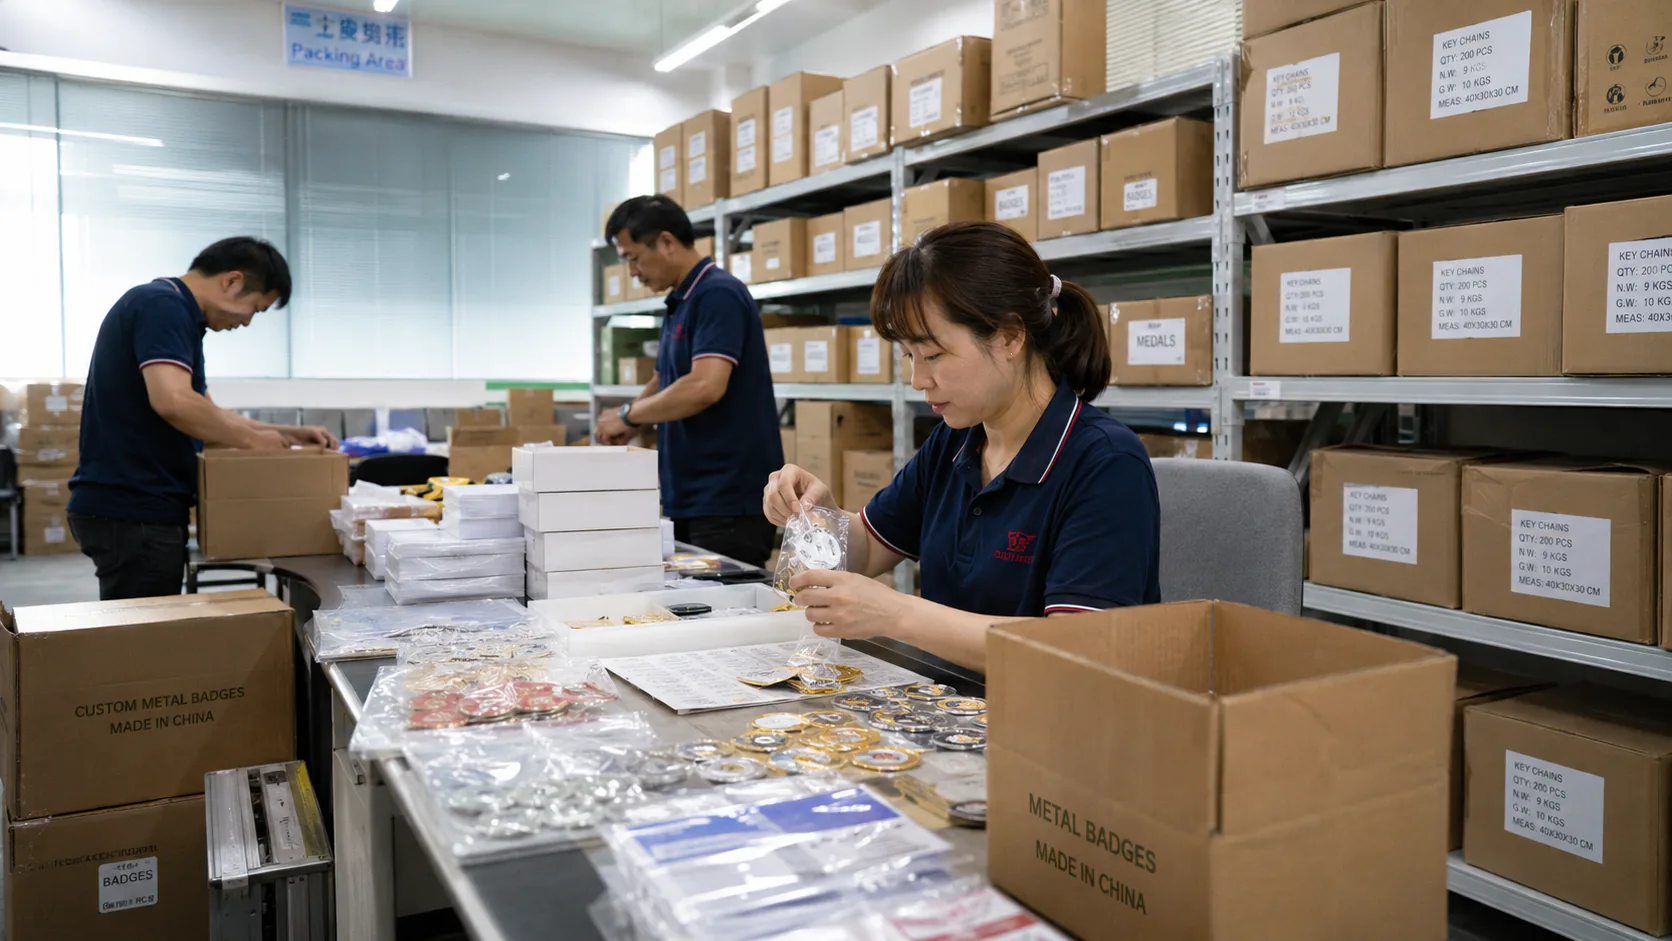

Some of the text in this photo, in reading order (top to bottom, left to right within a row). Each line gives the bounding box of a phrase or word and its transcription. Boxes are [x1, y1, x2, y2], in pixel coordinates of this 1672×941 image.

[1442, 31, 1490, 50] KEY CHAINS
[292, 42, 406, 70] Packing Area
[1440, 46, 1493, 65] QTY: 200 PCS
[1463, 66, 1468, 74] 9
[1470, 62, 1487, 72] KGS
[1462, 80, 1471, 89] 10
[1474, 76, 1491, 86] KGS
[1438, 96, 1462, 109] MEAS:
[1505, 85, 1519, 96] CM
[1619, 251, 1637, 261] KEY
[1441, 266, 1484, 277] KEY CHAINS
[1617, 264, 1672, 277] QTY: 200 PC
[1458, 282, 1470, 290] 200
[1472, 280, 1487, 288] PCS
[1616, 283, 1637, 292] N.W:
[1644, 282, 1650, 291] 9
[1461, 295, 1465, 303] 9
[1467, 294, 1482, 303] KGS
[1616, 297, 1672, 308] G.W: 10 KG
[1460, 308, 1468, 316] 10
[1470, 308, 1486, 316] KGS
[1616, 313, 1644, 323] MEAS:
[1500, 320, 1512, 328] CM
[1137, 334, 1176, 348] MEDALS
[1520, 520, 1569, 532] KEY CHAINS
[1519, 534, 1572, 548] QTY: 200 PCS
[1542, 551, 1548, 559] 9
[1550, 552, 1567, 562] KGS
[1542, 565, 1551, 574] 10
[1554, 567, 1572, 577] KGS
[1518, 576, 1544, 587] MEAS:
[1586, 586, 1600, 596] CM
[75, 686, 245, 718] CUSTOM METAL BADGES
[110, 710, 214, 735] MADE IN CHINA
[1514, 761, 1563, 783] KEY CHAINS
[1513, 775, 1566, 799] QTY: 200 PCS
[1536, 797, 1542, 805] 9
[1543, 798, 1561, 812] KGS
[1536, 811, 1545, 820] 10
[1548, 815, 1565, 827] KGS
[1029, 792, 1156, 874] METAL BADGES
[1580, 839, 1593, 851] CM
[103, 869, 153, 887] BADGES
[1036, 840, 1147, 915] MADE IN CHINA
